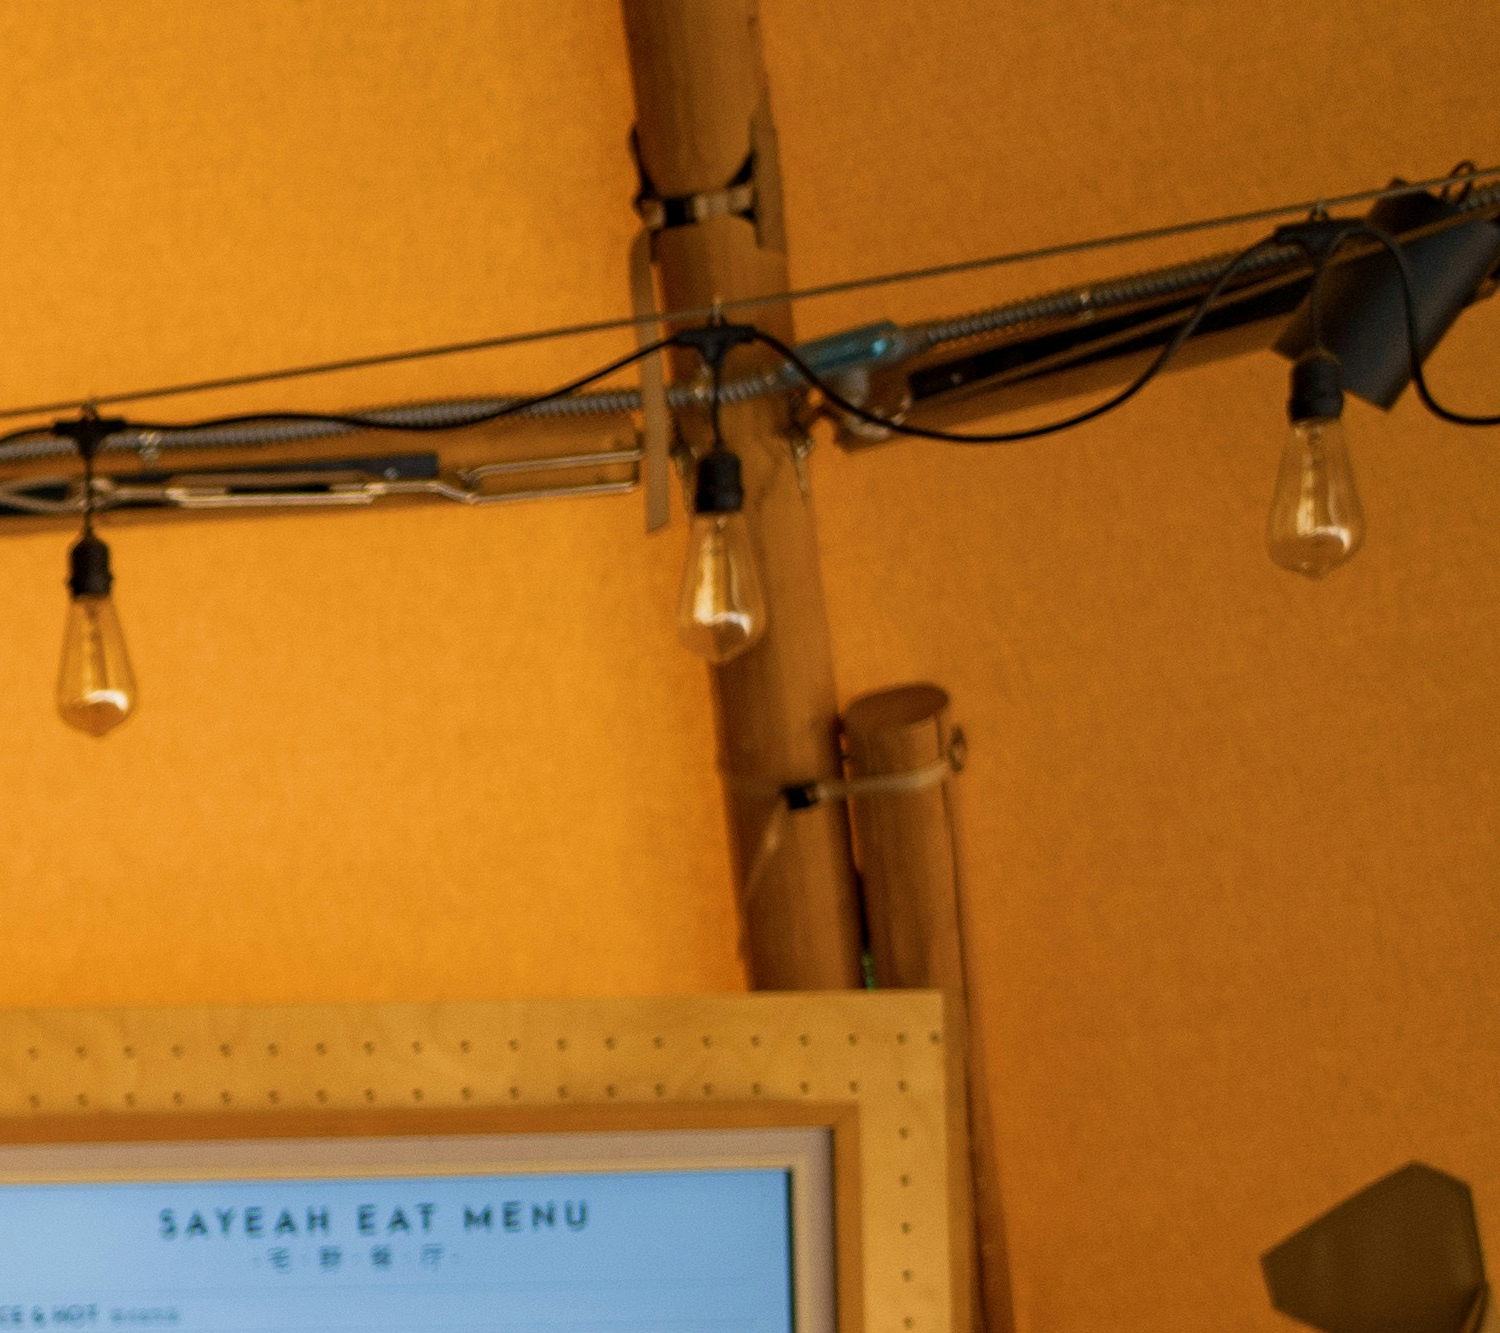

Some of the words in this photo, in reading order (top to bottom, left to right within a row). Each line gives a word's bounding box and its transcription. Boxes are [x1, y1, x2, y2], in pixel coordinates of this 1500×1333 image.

[158, 1206, 331, 1240] SAYEAH
[357, 1203, 436, 1236] EAT
[463, 1200, 589, 1233] MENU
